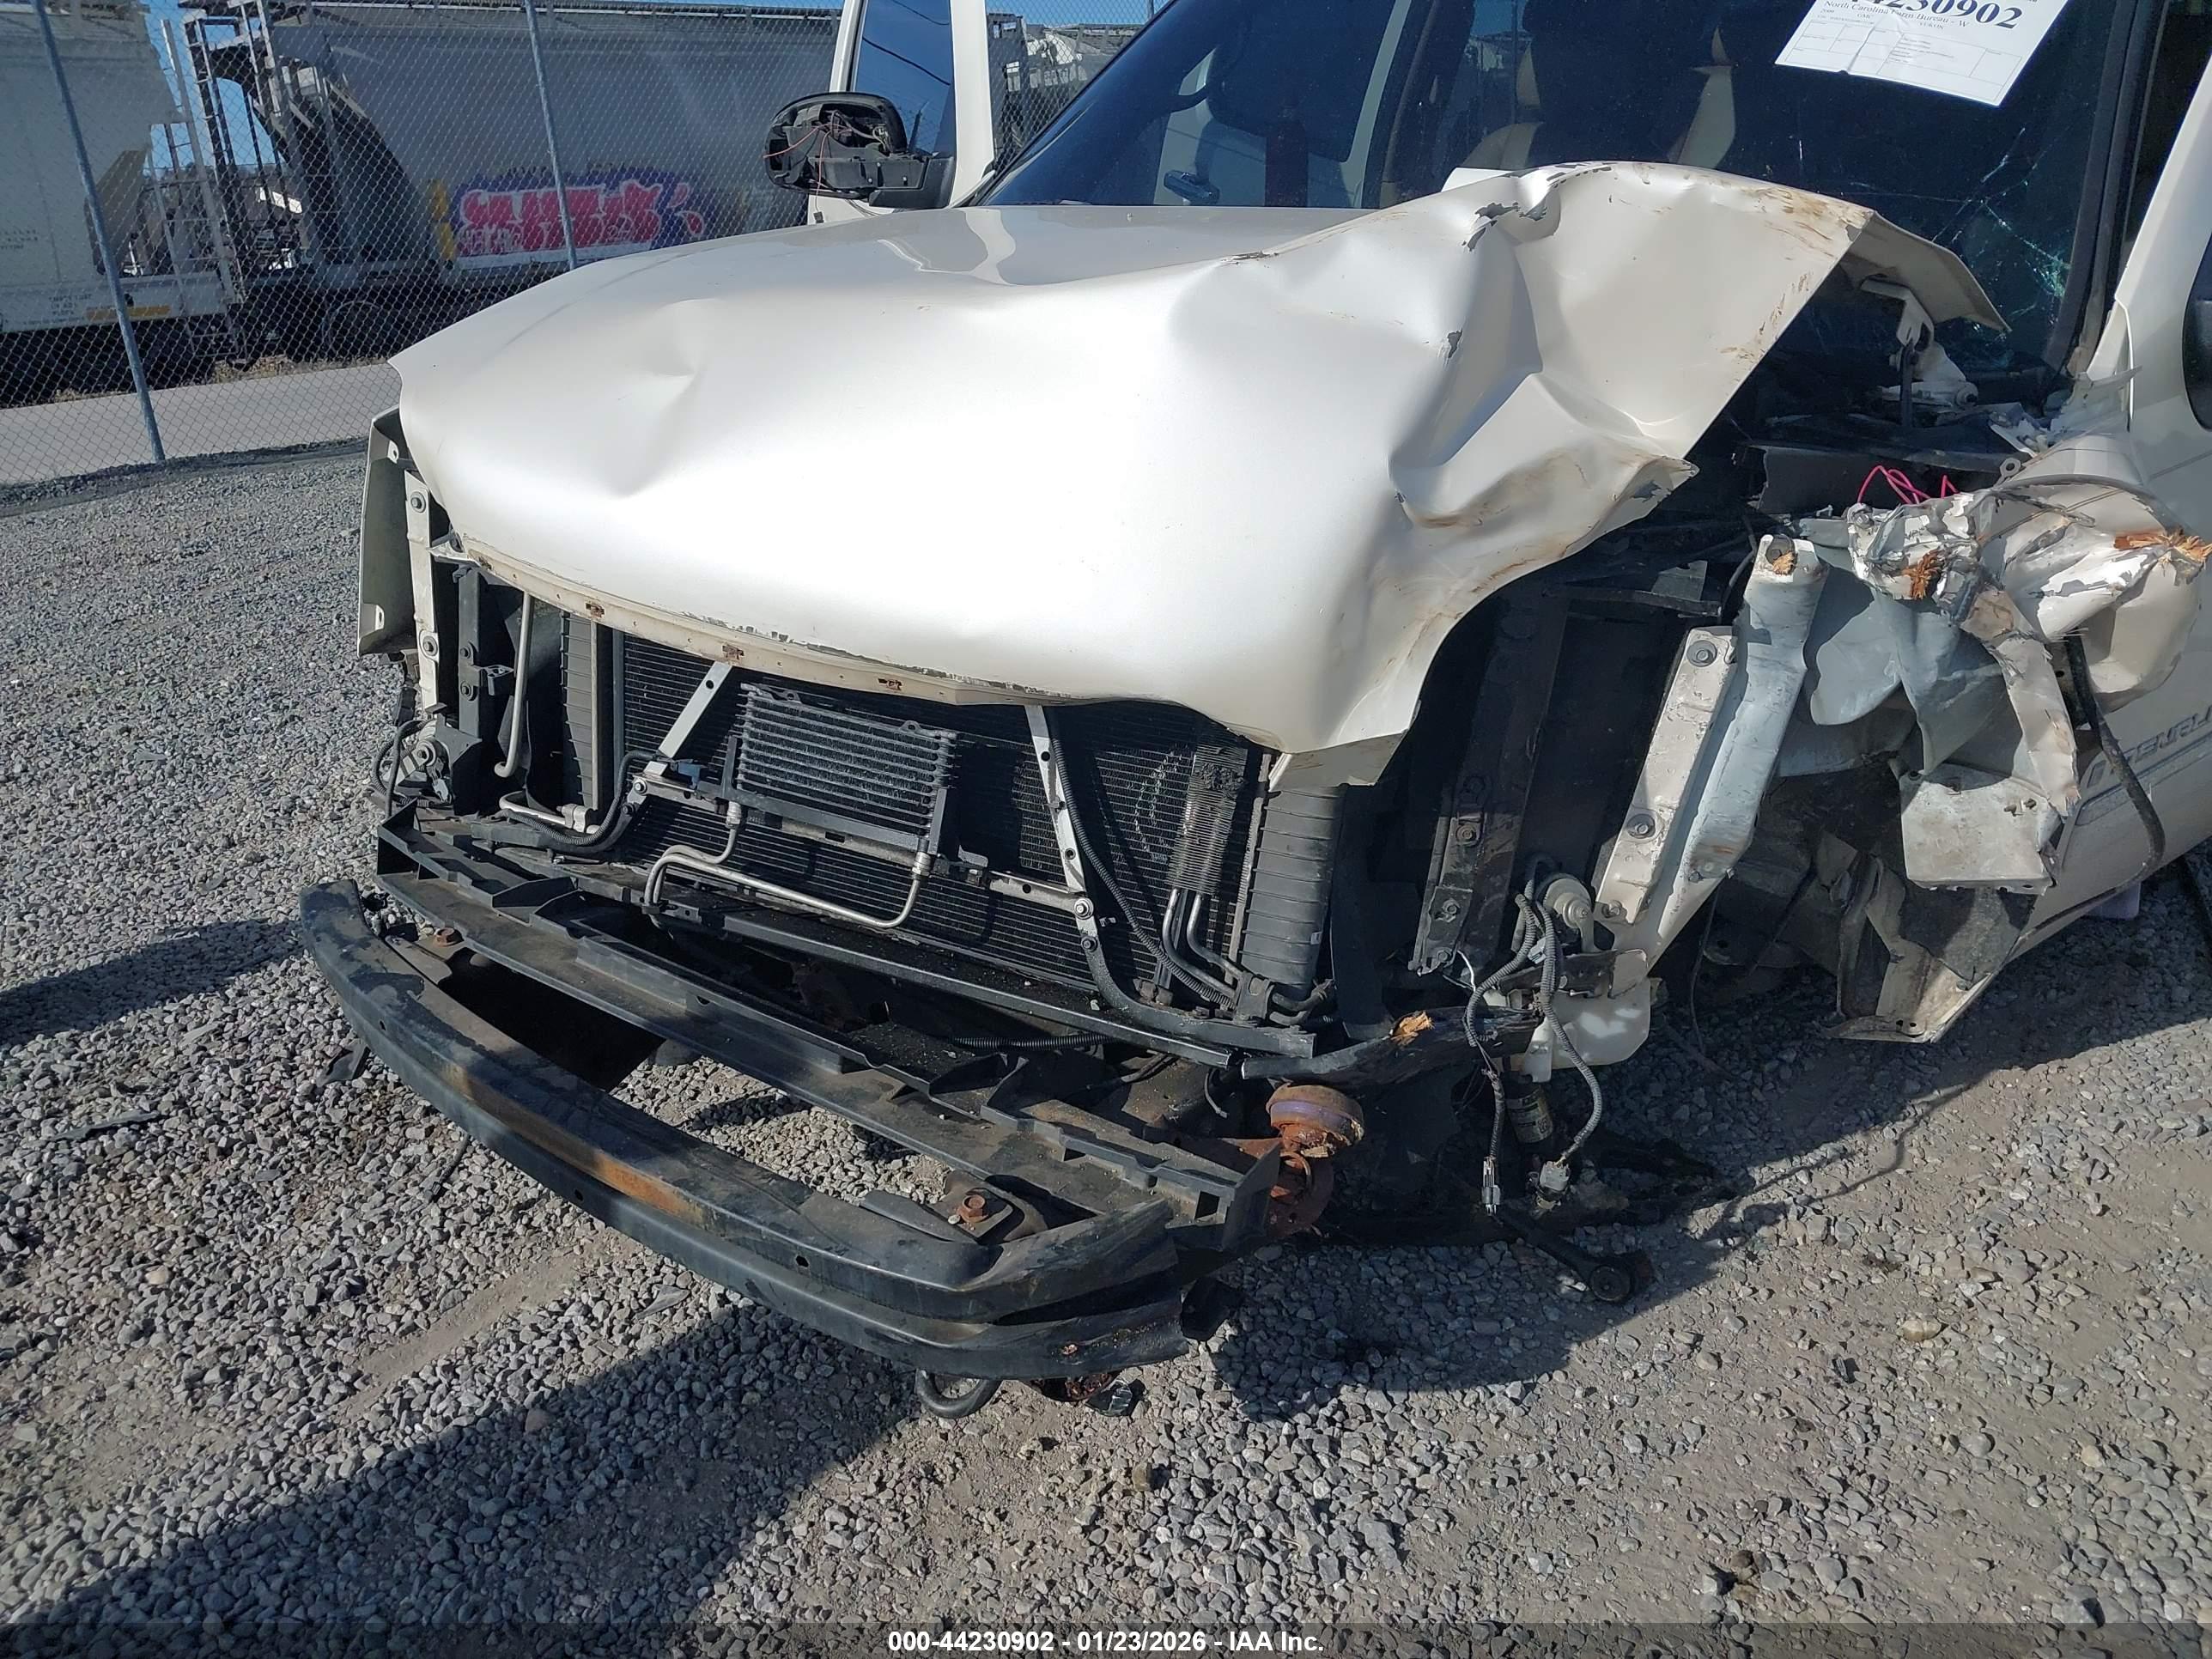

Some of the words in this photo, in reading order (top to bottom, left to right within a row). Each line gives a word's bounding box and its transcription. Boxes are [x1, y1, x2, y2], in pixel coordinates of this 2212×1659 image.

[1824, 0, 1850, 9] North
[1851, 3, 1889, 15] Carolina
[1891, 9, 1915, 19] Farm
[1917, 13, 1949, 24] Bureau
